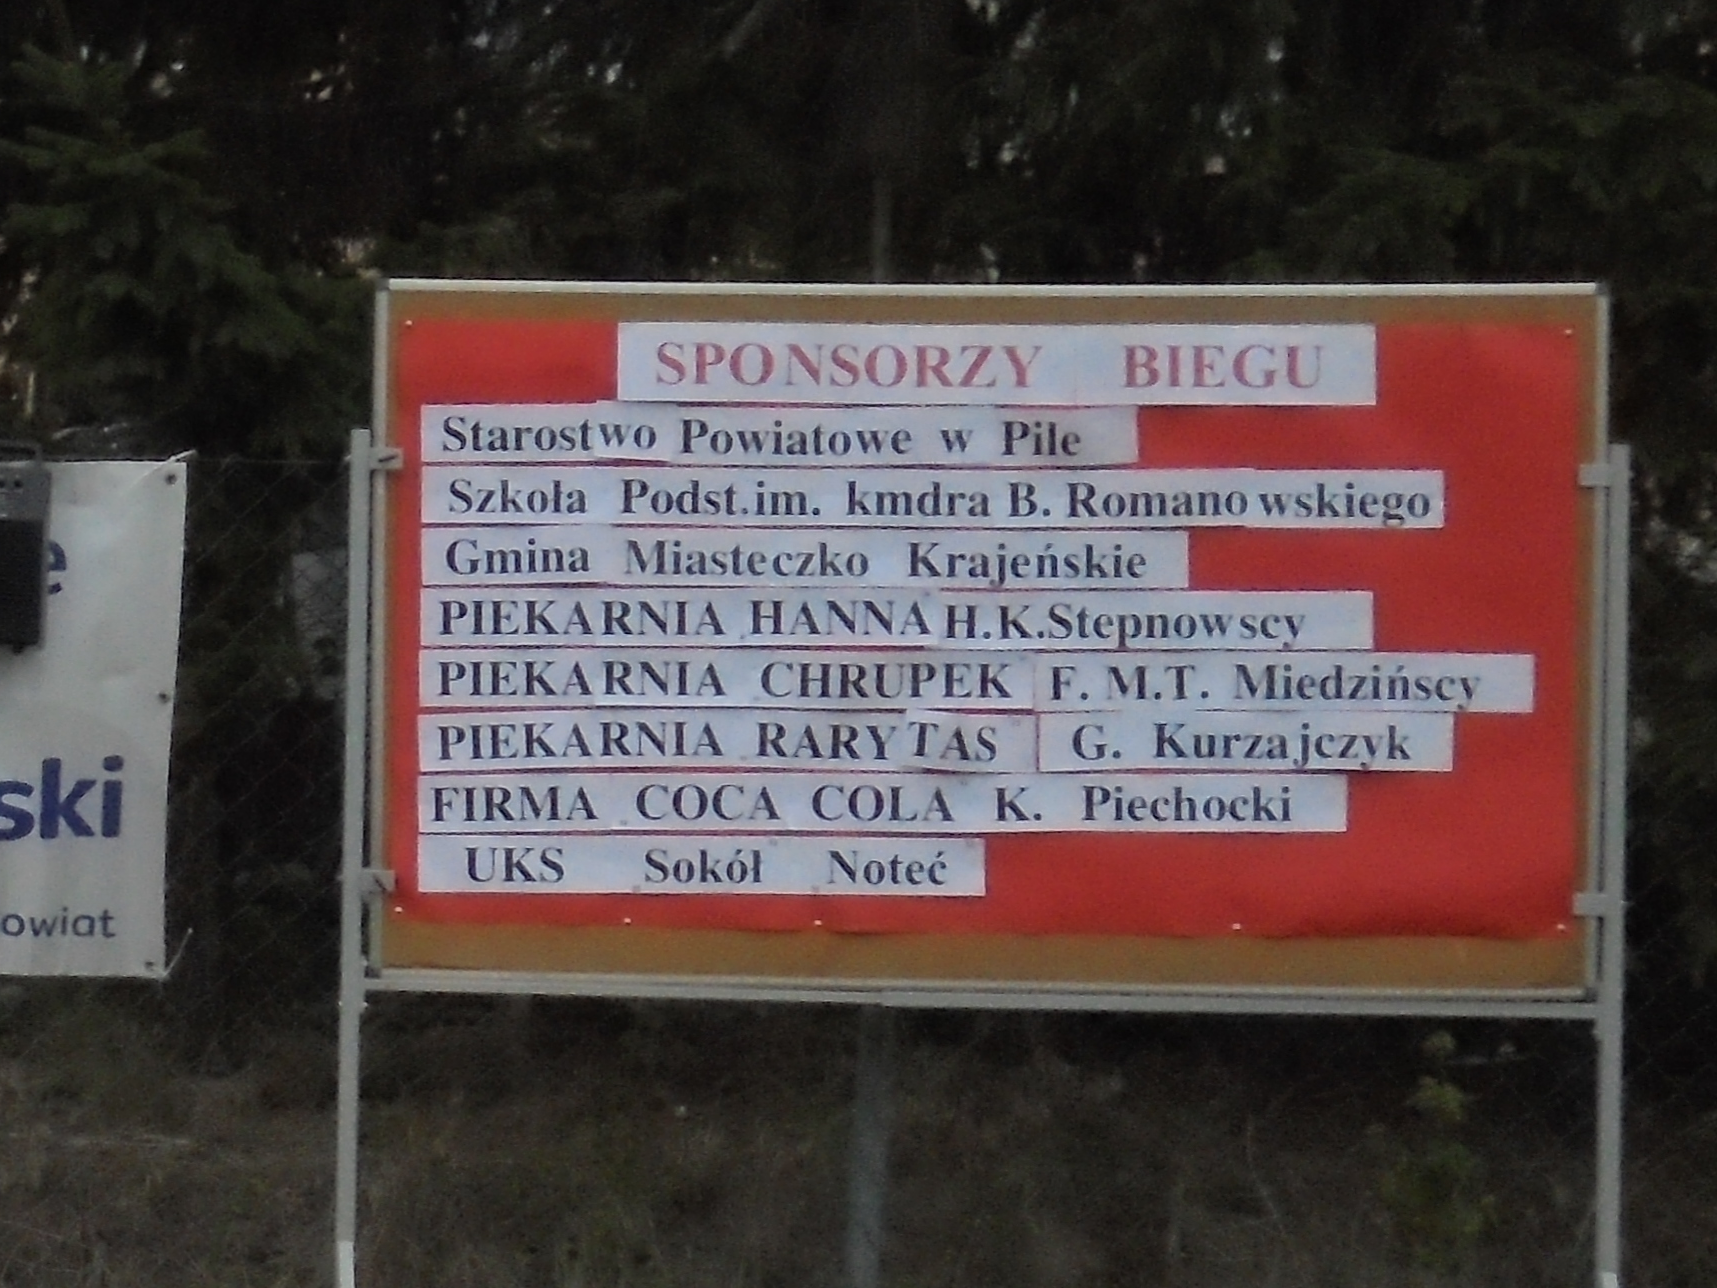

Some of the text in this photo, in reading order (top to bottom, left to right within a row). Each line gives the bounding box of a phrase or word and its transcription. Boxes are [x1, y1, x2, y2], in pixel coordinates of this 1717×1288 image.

[655, 340, 1324, 390] SPONSORZY BIEGU
[441, 415, 1082, 457] Starostwo Powiatowe w Pile
[448, 477, 588, 515] Szkoła
[846, 479, 991, 518] kmdra
[1006, 481, 1052, 519] B.
[445, 537, 1148, 587] Gmina Miasteczko Krajeńskie
[438, 598, 726, 637] PIEKARNIA
[749, 598, 932, 637] HANNA
[437, 660, 727, 699] PIEKARNIA
[760, 661, 1014, 700] CHRUPEK
[1049, 665, 1090, 701] F.
[1232, 662, 1482, 710] Miedzińscy
[437, 720, 1413, 769] PIEKARNIA RARYTAS G. Kurzajczyk
[431, 783, 1293, 824] FIRMA COCA COLA K. Piechocki
[465, 845, 949, 886] UKS Sokół Noteć
